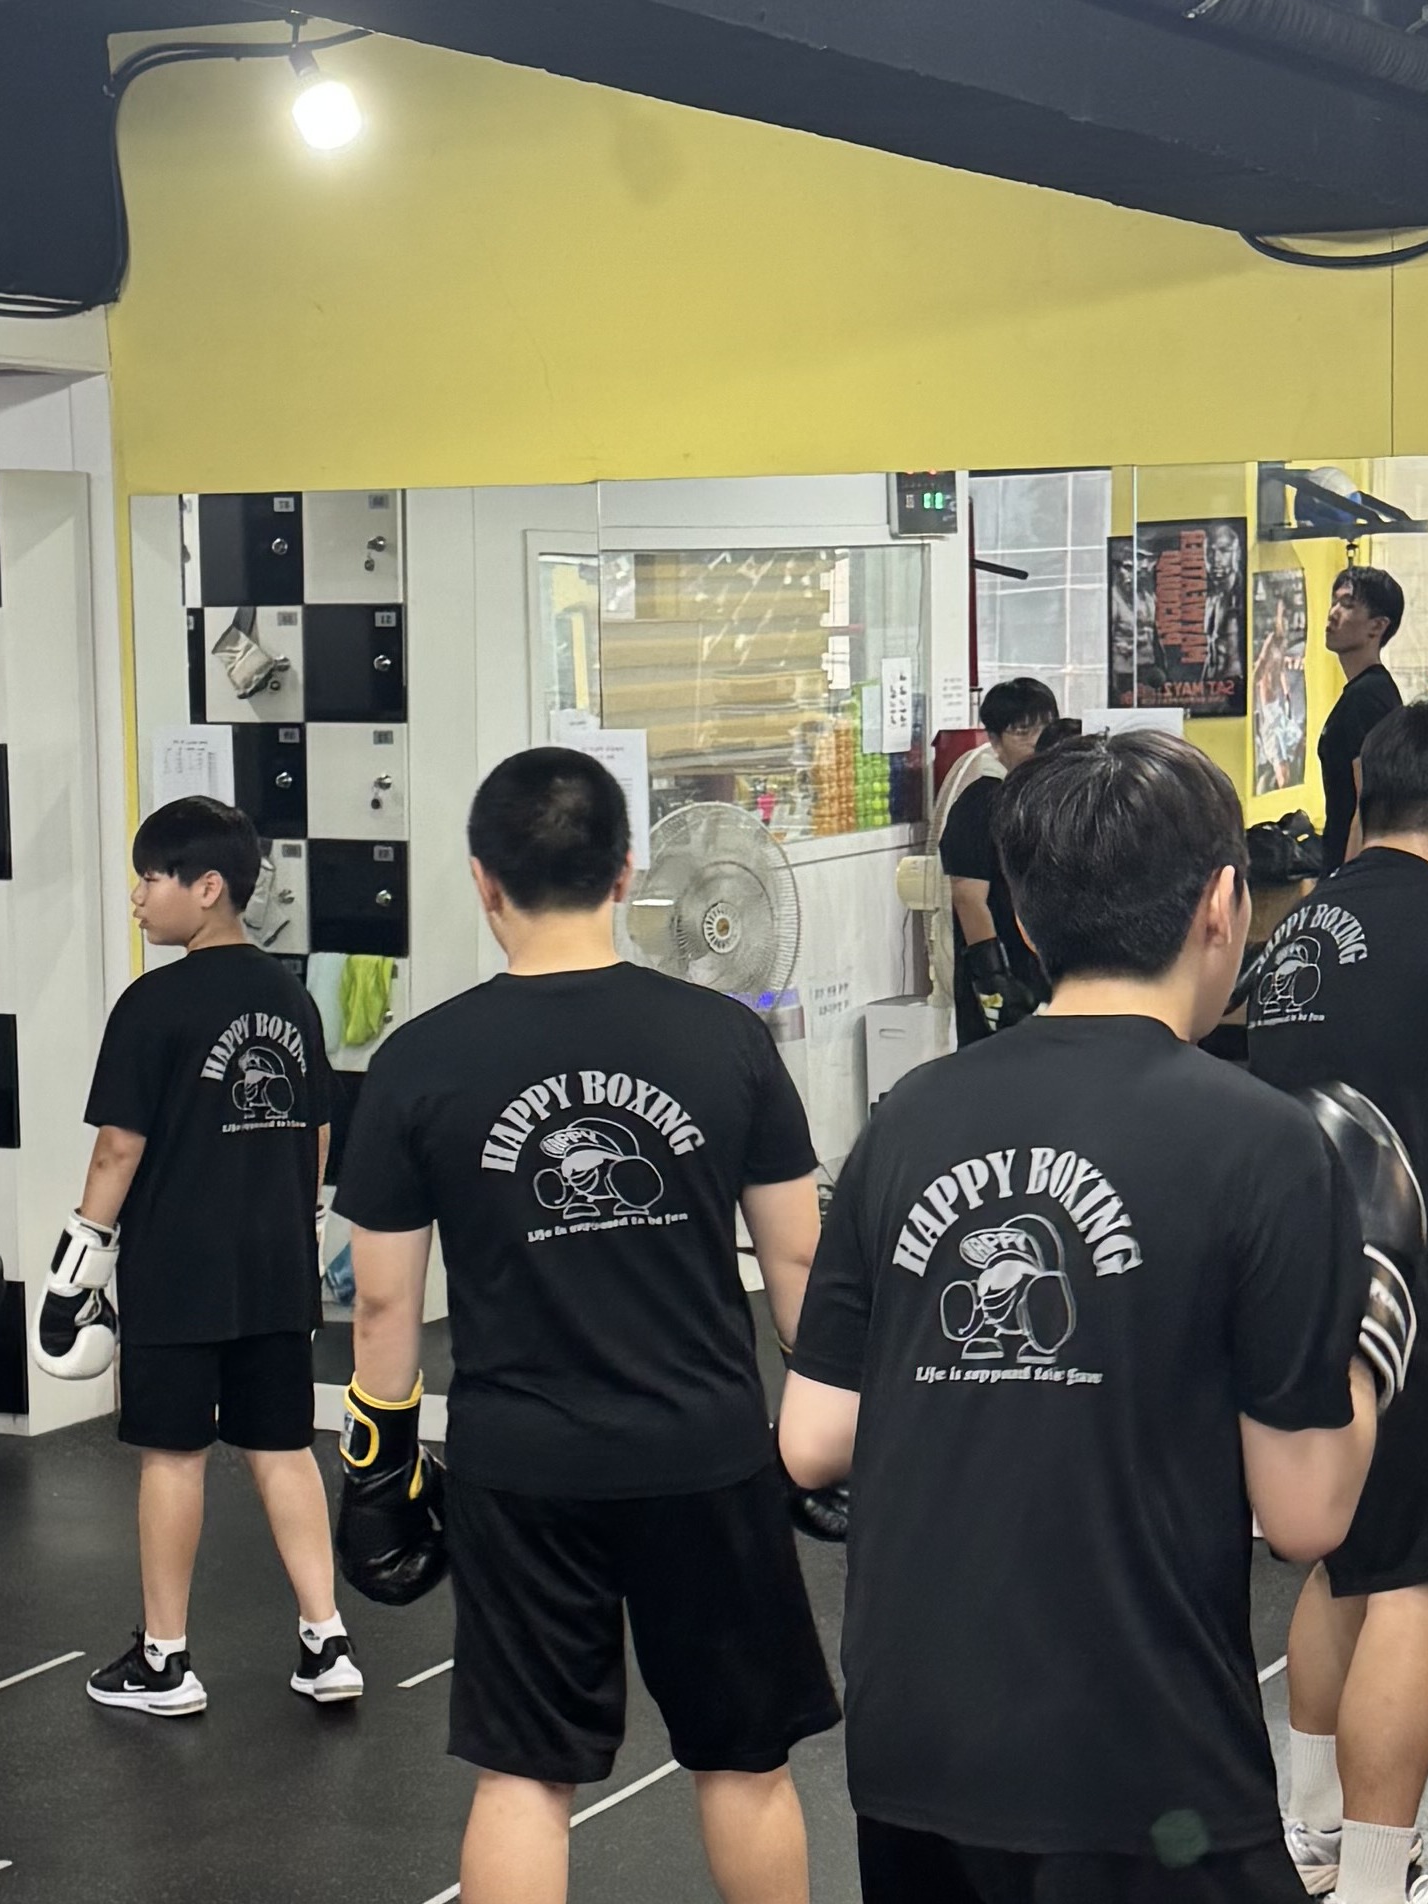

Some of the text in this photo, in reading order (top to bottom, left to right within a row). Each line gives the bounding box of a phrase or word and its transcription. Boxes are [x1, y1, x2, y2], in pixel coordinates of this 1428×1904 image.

[1310, 903, 1368, 965] BOXING
[200, 1012, 250, 1082] HAPPY
[481, 1070, 706, 1173] HAPPY BOXING
[892, 1147, 1144, 1278] HAPPY BOXING
[915, 1366, 947, 1383] Life
[949, 1365, 962, 1381] is
